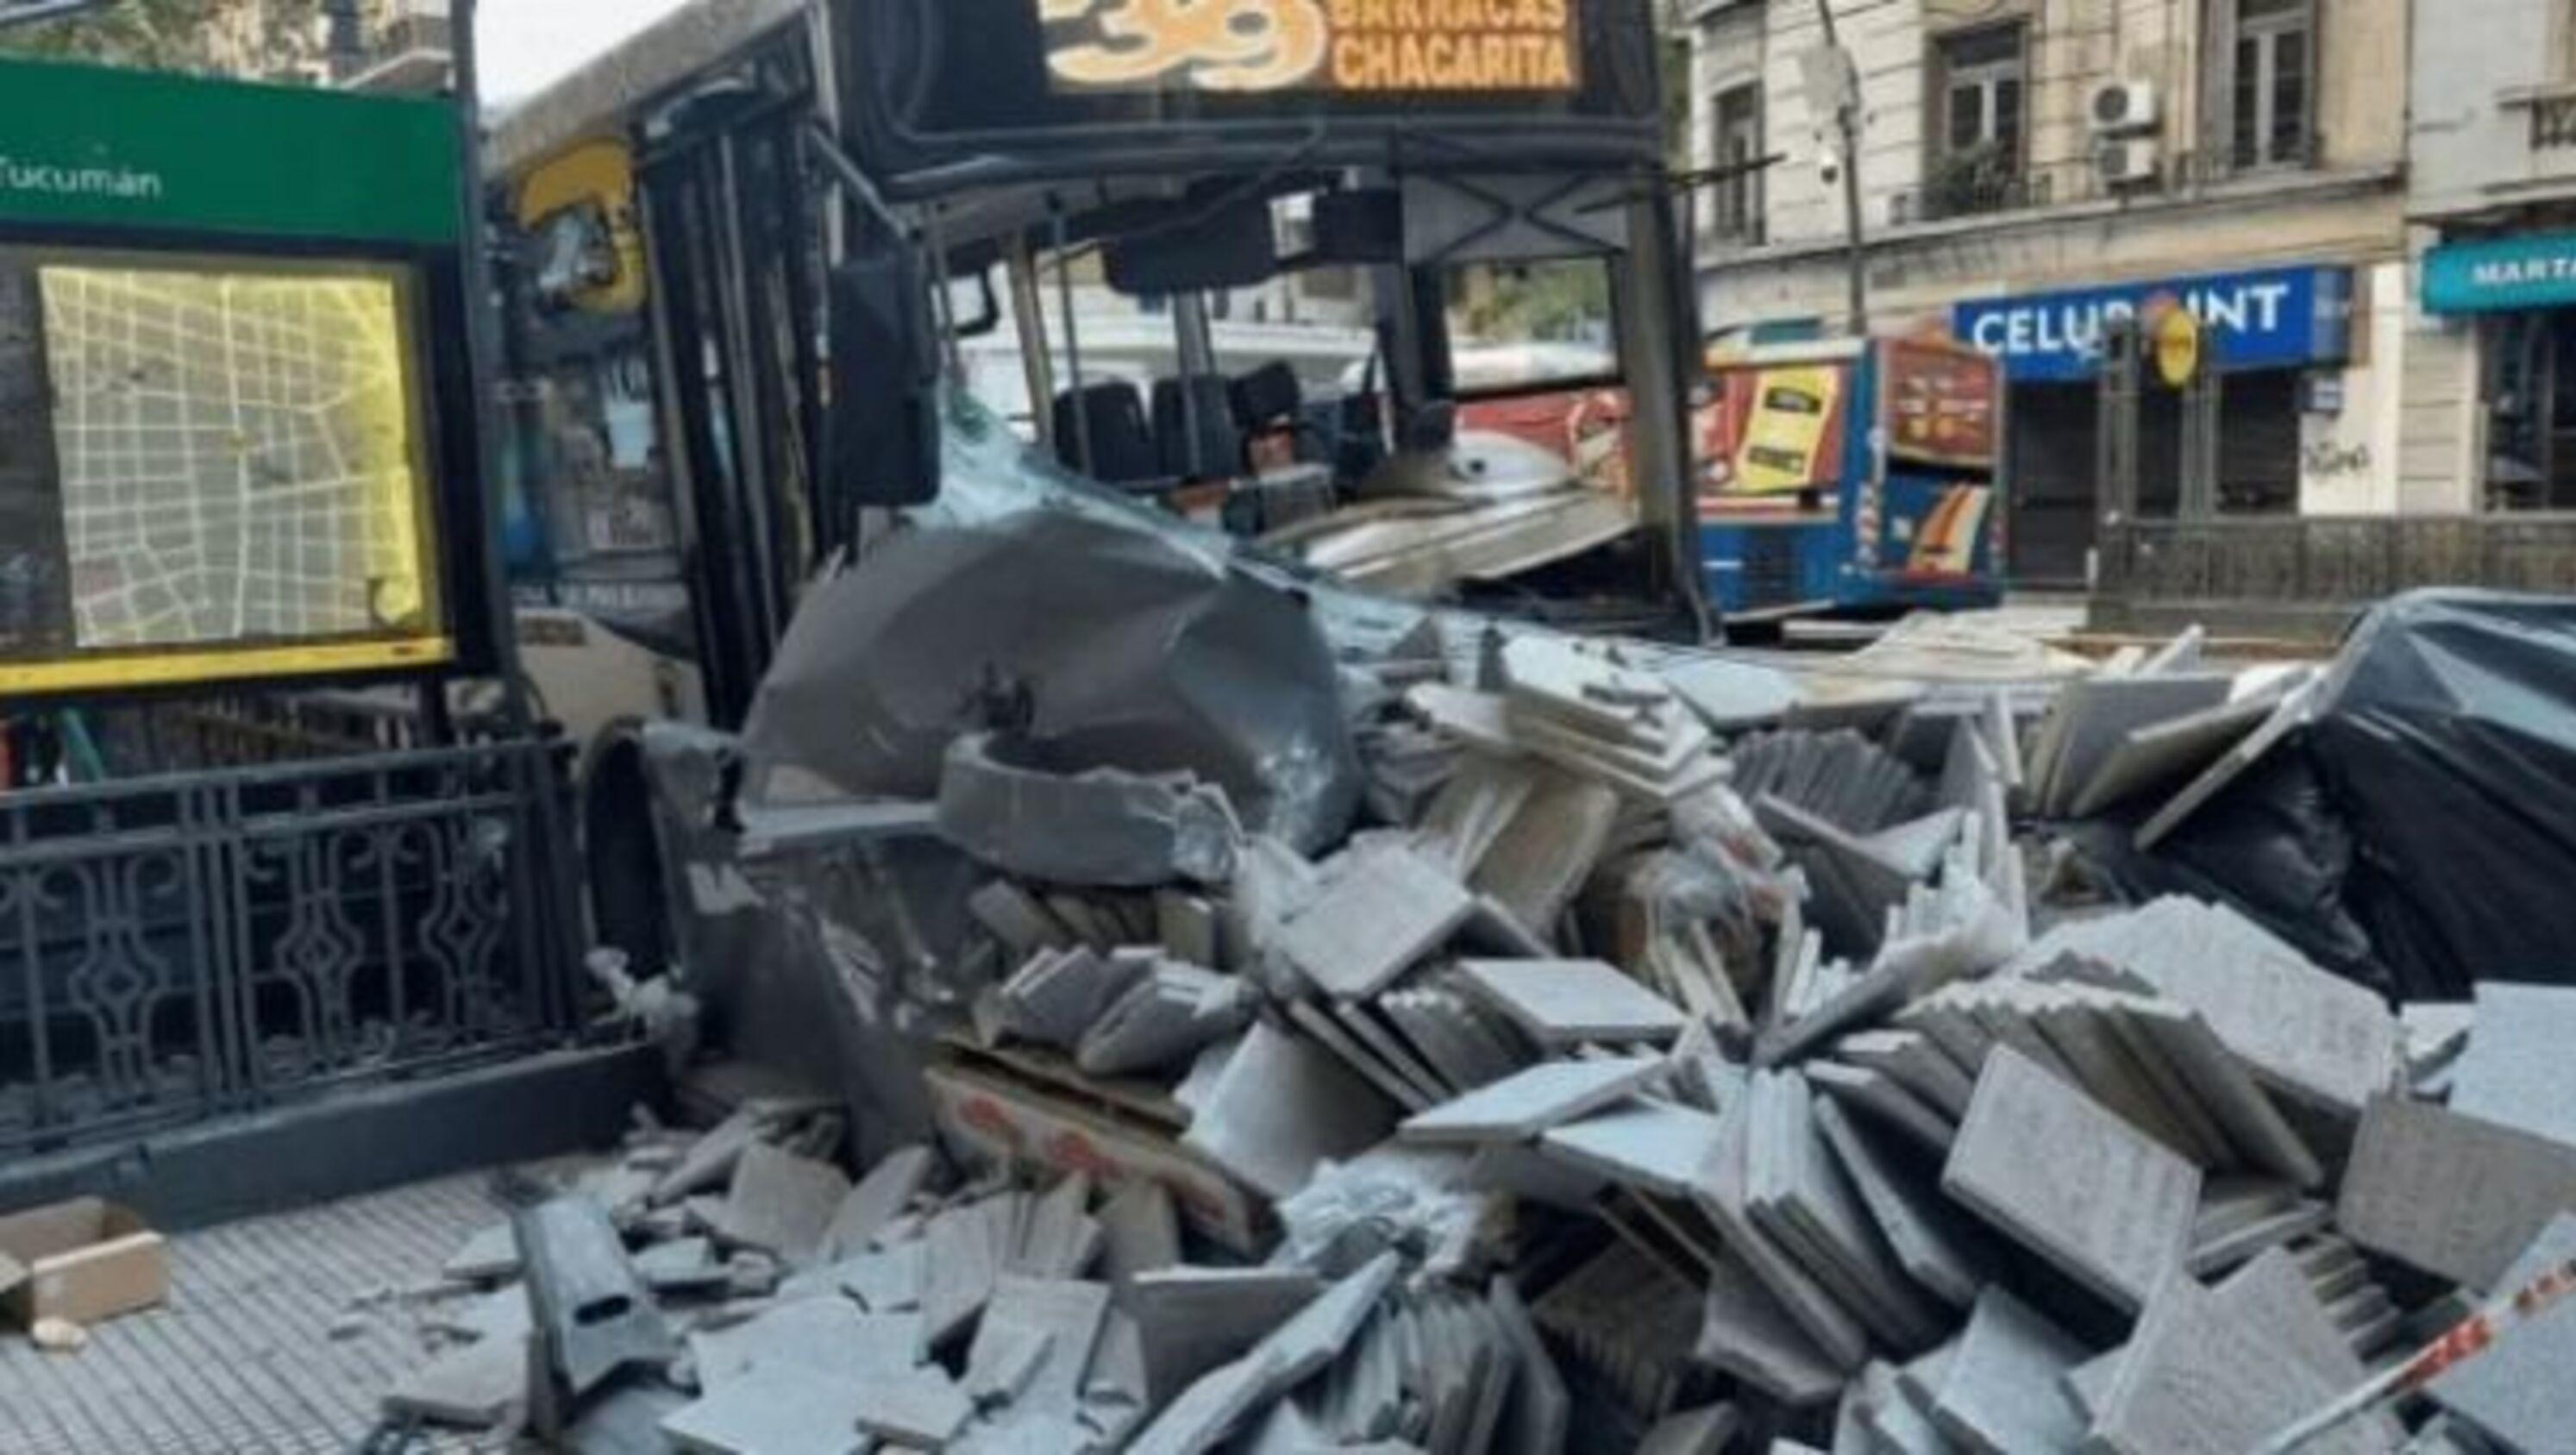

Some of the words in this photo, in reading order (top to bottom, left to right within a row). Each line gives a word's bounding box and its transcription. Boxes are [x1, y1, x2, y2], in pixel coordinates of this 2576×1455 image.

[1038, 0, 1328, 90] 39
[1333, 32, 1572, 88] CHACARITA
[2473, 258, 2576, 285] MART
